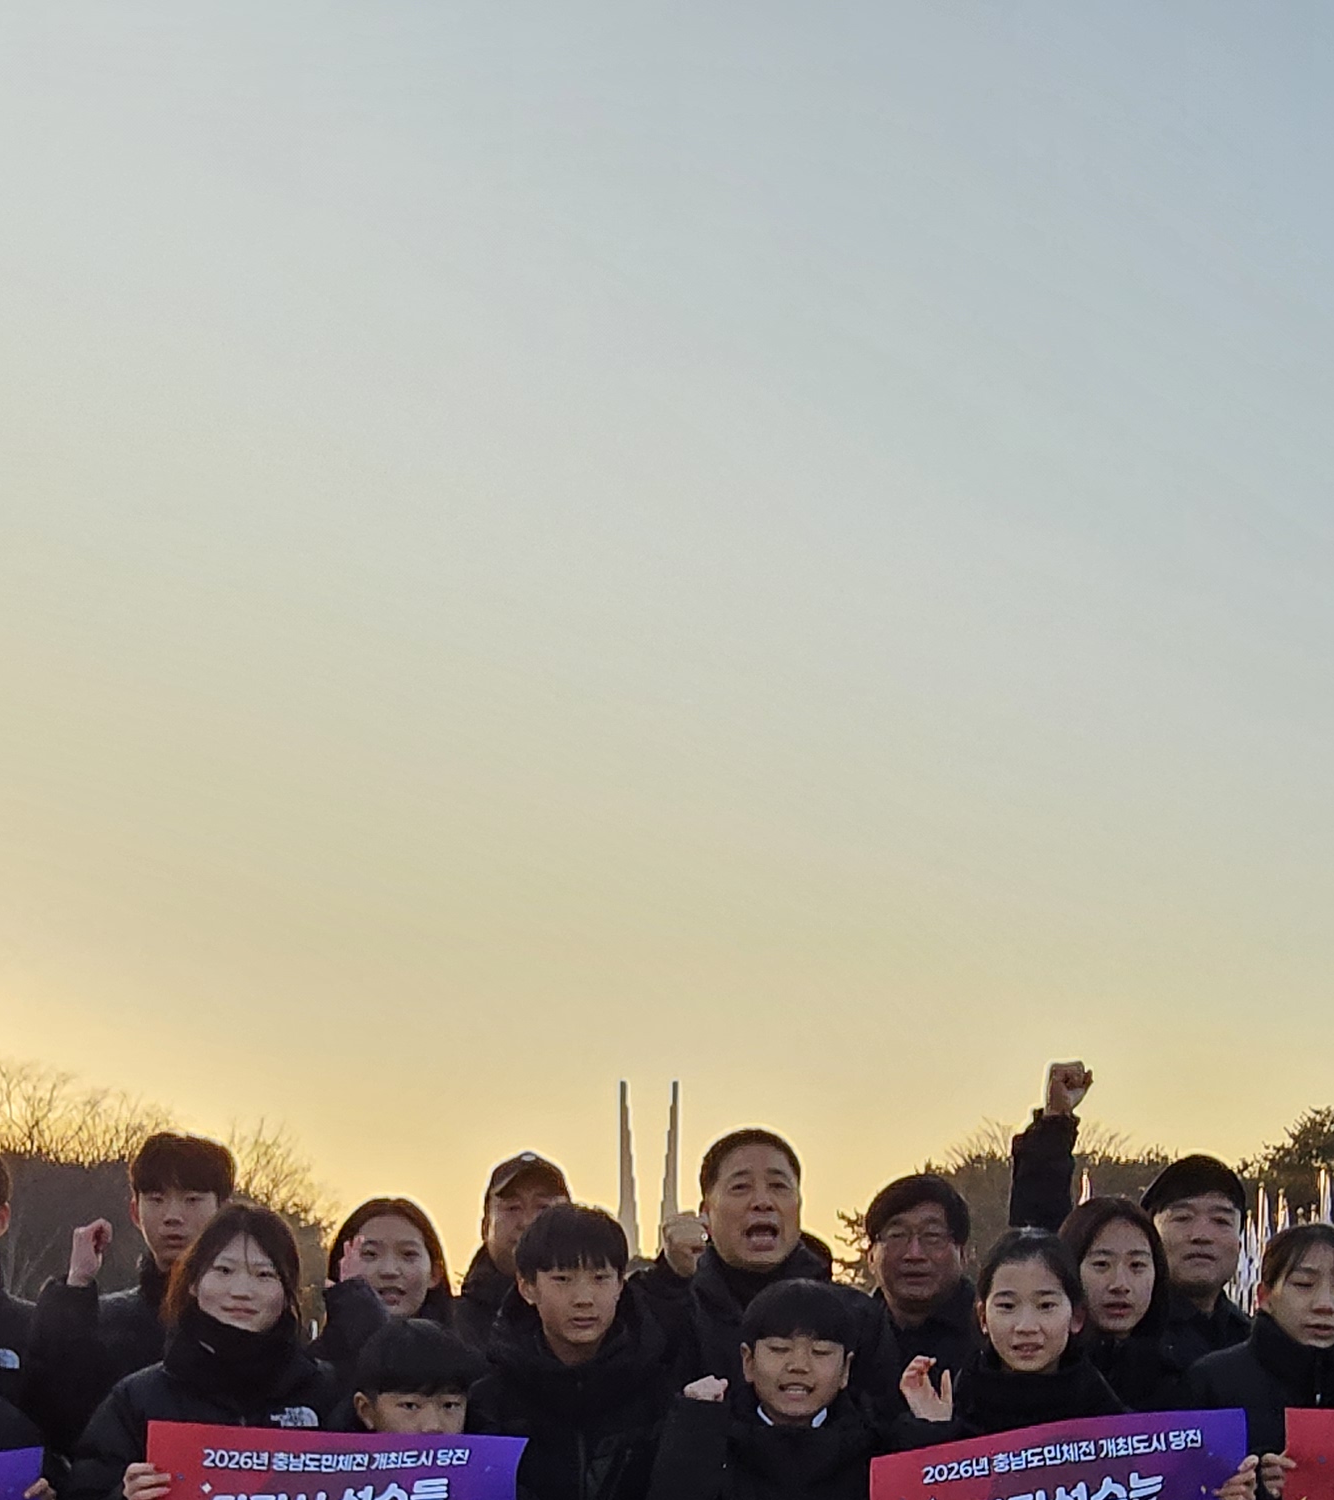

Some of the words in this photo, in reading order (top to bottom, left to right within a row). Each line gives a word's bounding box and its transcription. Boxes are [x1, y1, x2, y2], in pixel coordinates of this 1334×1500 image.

[202, 1449, 268, 1470] 2026년
[272, 1450, 368, 1472] 충남도민체전
[370, 1449, 434, 1471] 개최도시
[436, 1448, 470, 1467] 당진
[922, 1456, 989, 1484] 2026년
[992, 1443, 1096, 1474] 충남도민체전
[1099, 1434, 1167, 1458] 개최도시
[1168, 1428, 1202, 1449] 당진
